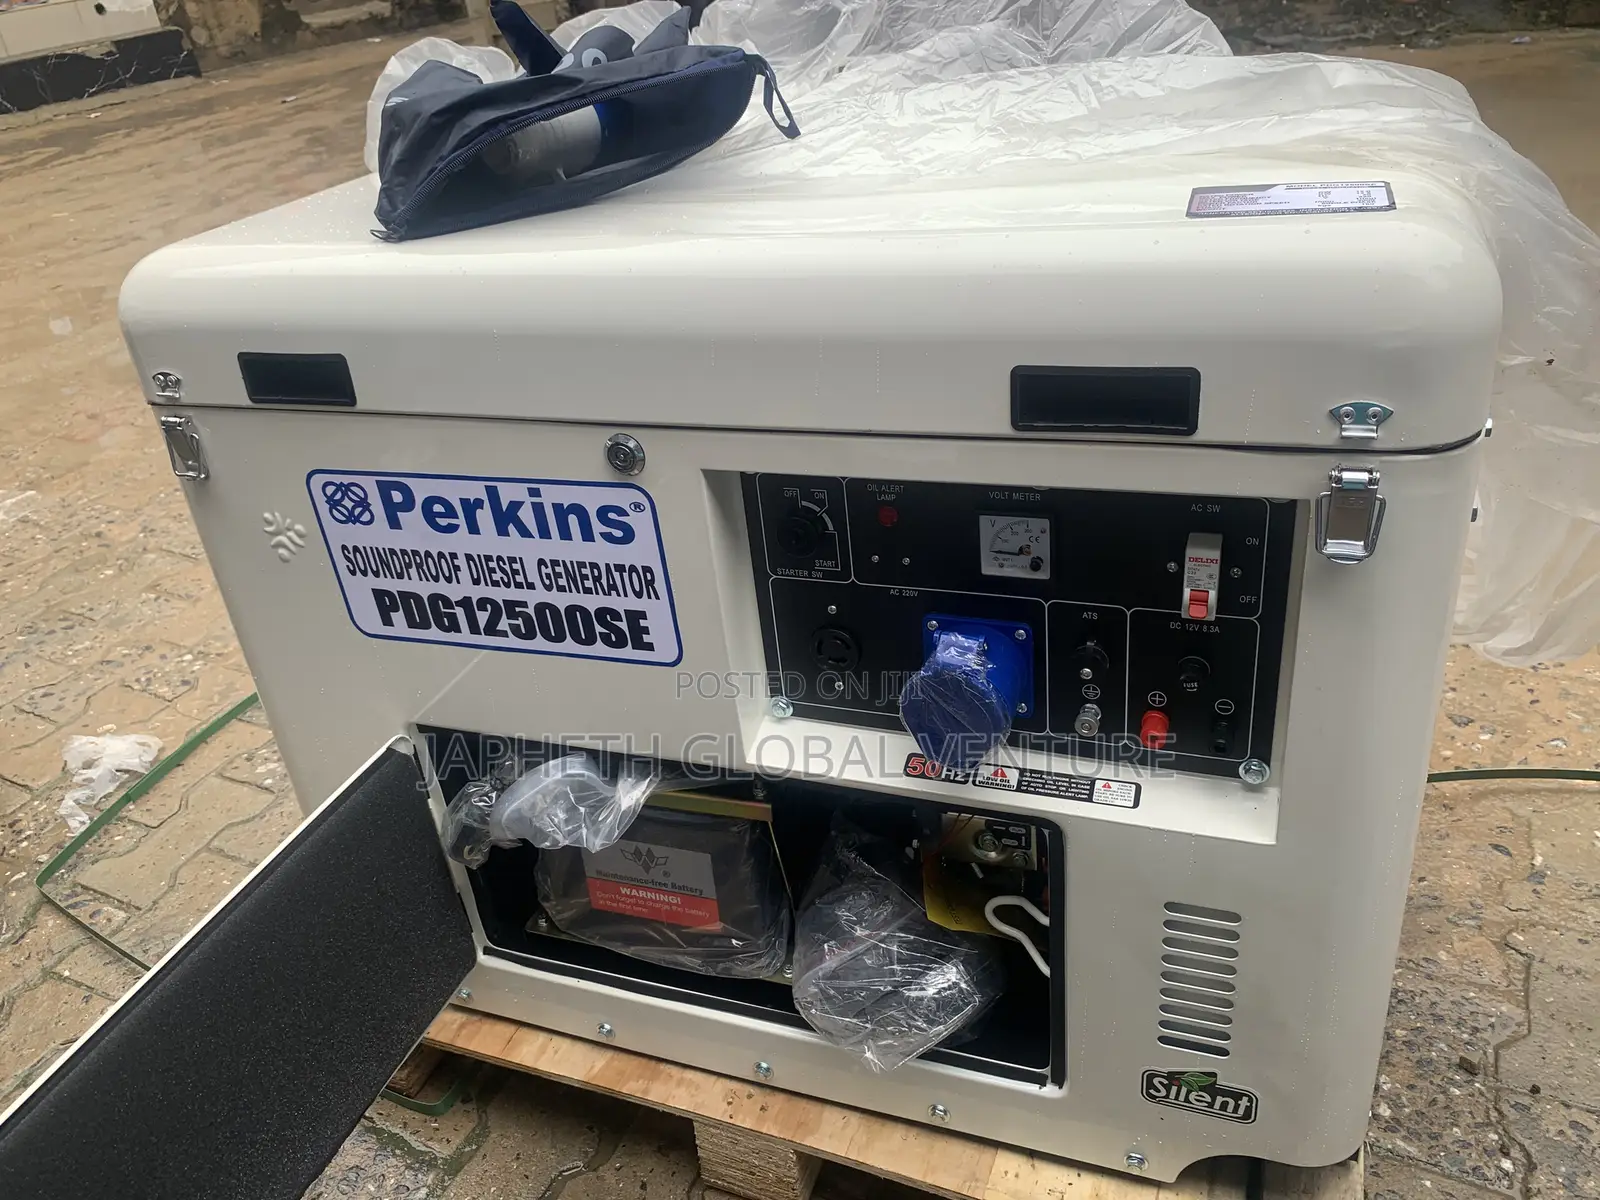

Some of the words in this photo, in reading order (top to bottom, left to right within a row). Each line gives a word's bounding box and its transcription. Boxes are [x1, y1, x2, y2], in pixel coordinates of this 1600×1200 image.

[866, 483, 879, 492] OIL
[880, 484, 905, 494] ALERT
[784, 489, 798, 499] OFF
[813, 491, 825, 500] ON
[876, 493, 897, 502] LAMP
[988, 490, 1010, 500] VOLT
[1012, 491, 1041, 502] METER
[376, 479, 636, 546] Perkins
[1190, 503, 1203, 512] AC
[1206, 503, 1221, 513] SW
[1245, 536, 1260, 546] ON
[814, 559, 837, 568] START
[1188, 556, 1219, 565] DELIXI
[341, 543, 463, 585] SOUNDPROOF
[464, 552, 537, 592] DIESEL
[537, 558, 661, 601] GENERATOR
[776, 567, 809, 578] STARTER
[811, 570, 824, 579] SW
[889, 588, 900, 597] AC
[902, 589, 919, 598] 220V
[1239, 594, 1258, 605] OFF
[371, 588, 655, 652] PDG12500SE
[1081, 611, 1098, 620] ATS
[1169, 621, 1182, 630] DC
[1185, 622, 1200, 632] 12V
[1202, 624, 1221, 634] 8.3A
[1183, 681, 1199, 689] FUSE
[977, 780, 1016, 790] WARNING!
[982, 775, 999, 783] LOW
[999, 776, 1011, 785] OIL
[595, 868, 669, 889] Maintenance-free
[671, 881, 704, 896] Battery
[619, 886, 681, 905] WARNING!
[1148, 1075, 1251, 1116] Silent
